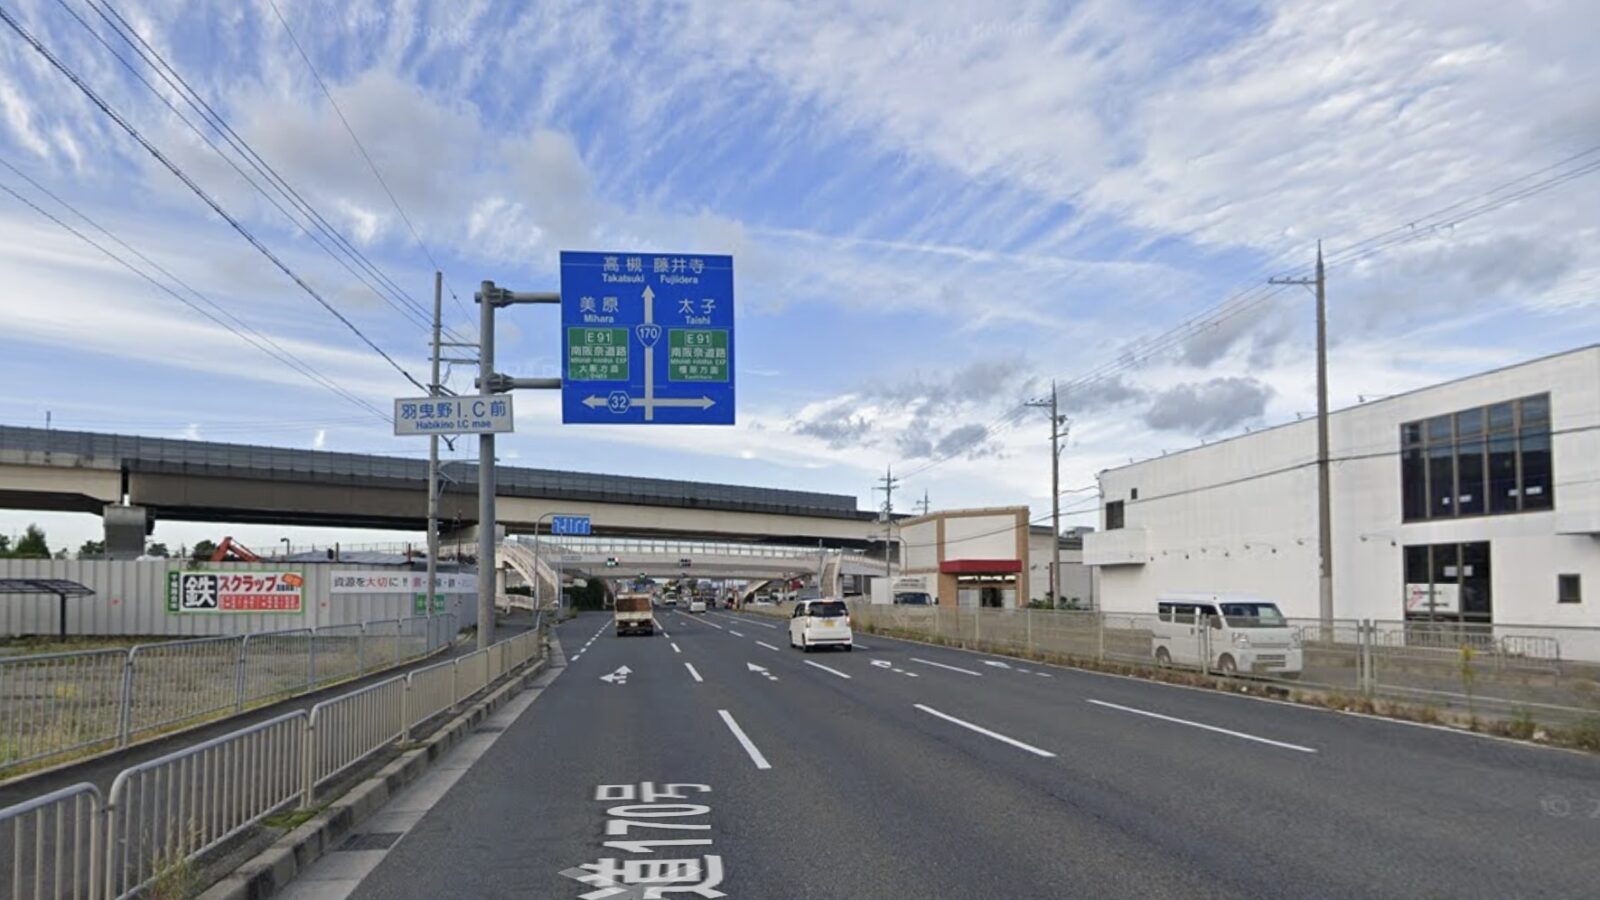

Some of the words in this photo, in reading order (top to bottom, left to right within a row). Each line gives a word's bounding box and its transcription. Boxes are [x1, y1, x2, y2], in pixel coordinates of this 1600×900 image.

[603, 256, 642, 272] 高槻
[653, 257, 704, 274] 藤井寺
[602, 273, 645, 283] Takatsuki
[580, 296, 619, 313] 美原
[678, 298, 717, 315] 太子
[584, 314, 614, 324] Mihara
[685, 315, 711, 325] Taishi
[639, 327, 657, 338] 170
[611, 396, 626, 409] 32
[416, 421, 455, 430] Habikino
[472, 420, 492, 428] mae
[219, 574, 276, 592] スクラップ
[185, 576, 216, 607] 鉄
